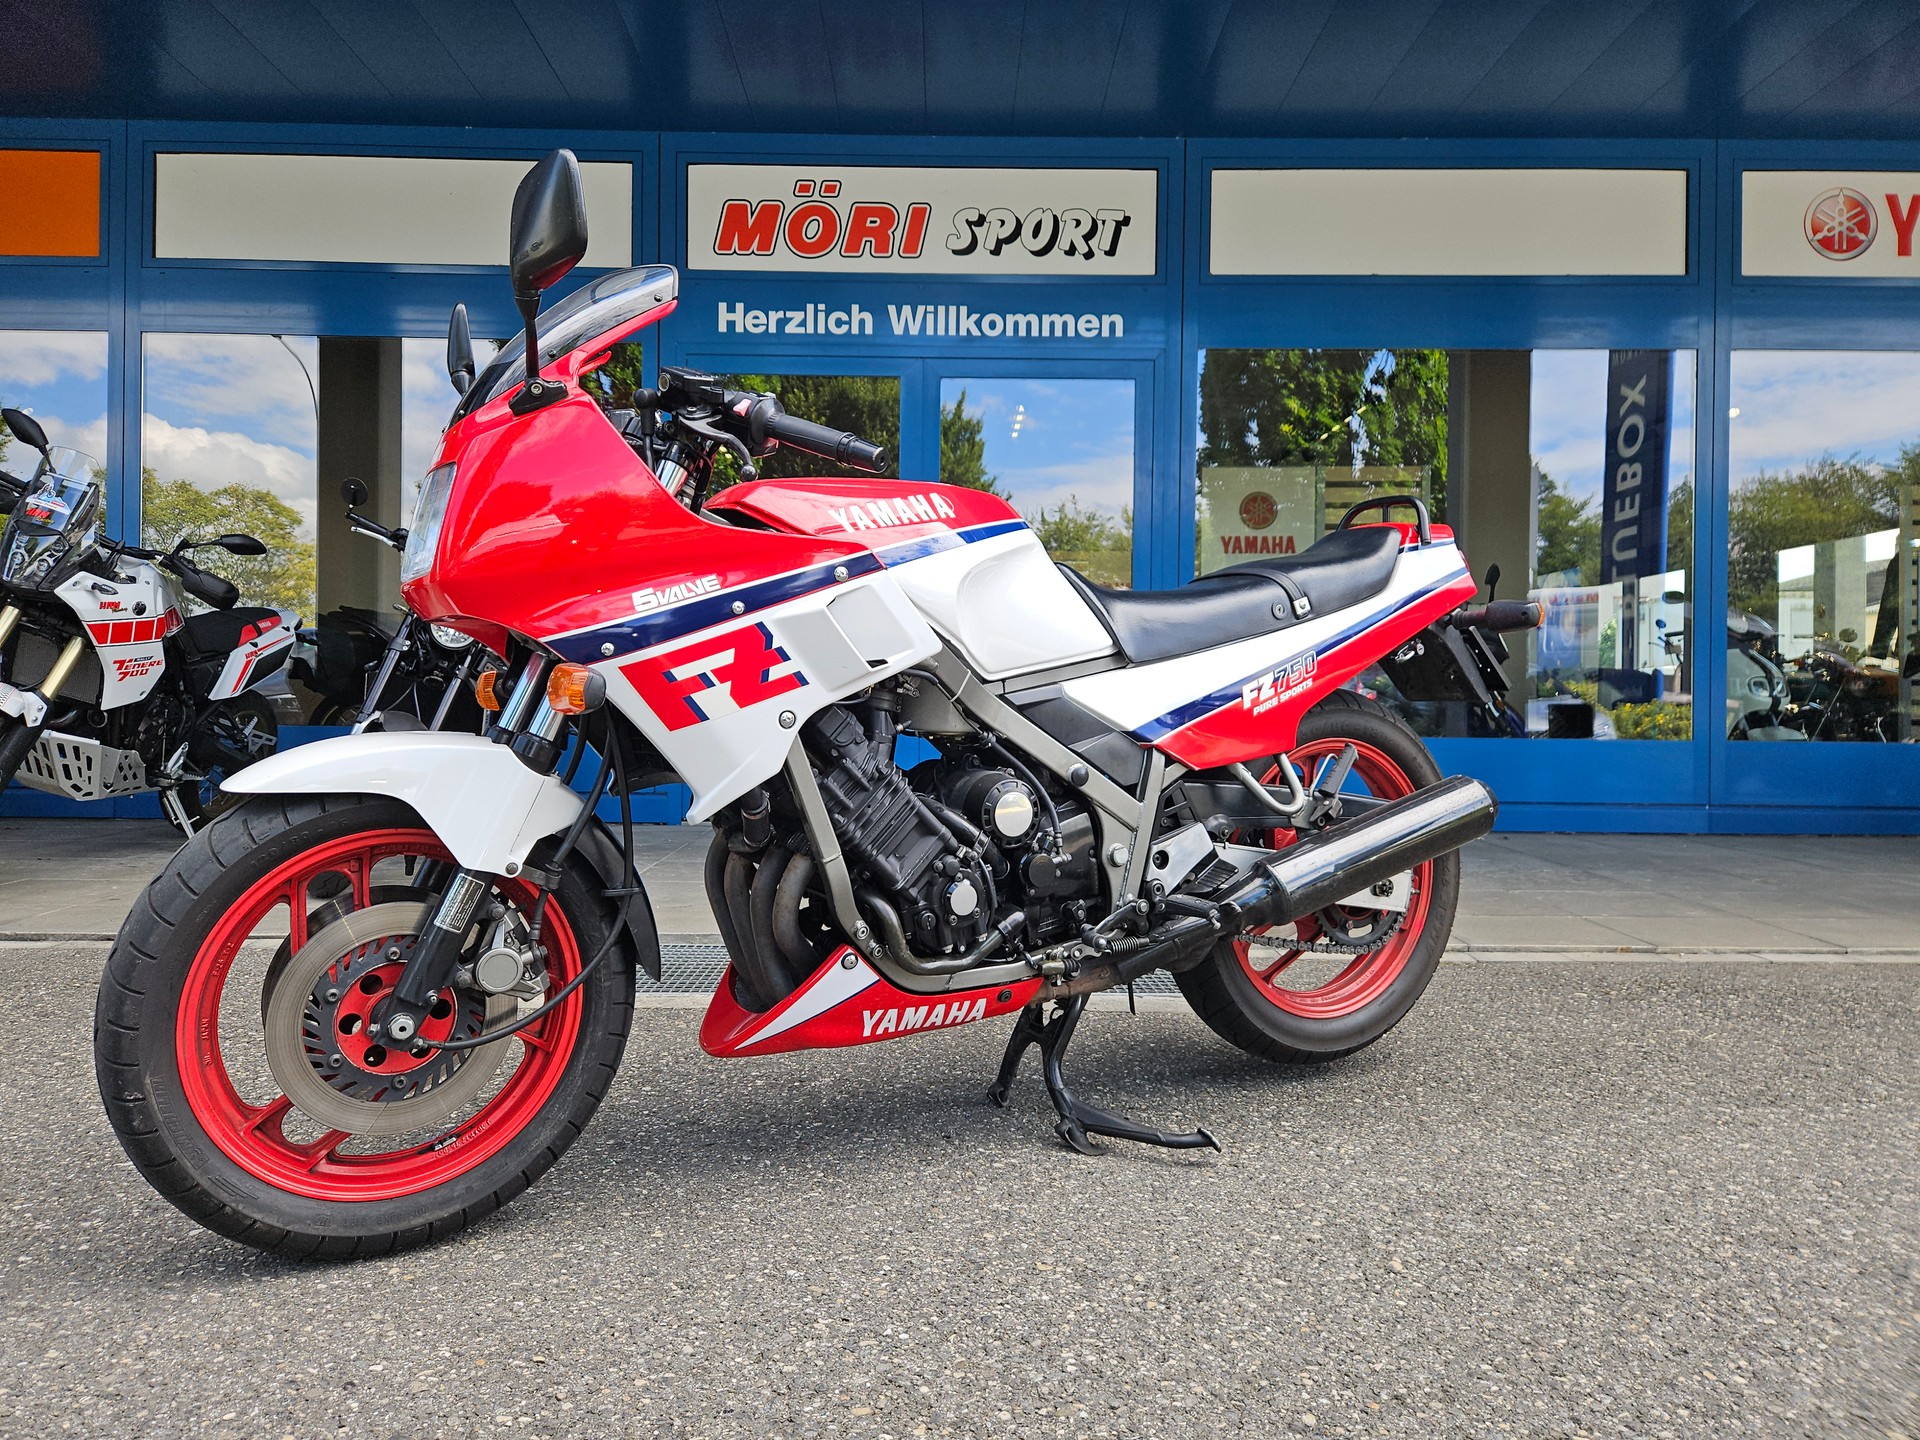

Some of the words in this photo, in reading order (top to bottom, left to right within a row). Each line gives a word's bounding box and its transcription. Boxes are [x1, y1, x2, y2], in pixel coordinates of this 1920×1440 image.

[713, 179, 932, 259] MÖRI
[946, 207, 1132, 261] SPORT
[718, 302, 873, 335] Herzlich
[888, 304, 1124, 338] Willkommen
[828, 492, 956, 533] YAMAHA
[1220, 535, 1296, 554] YAMAHA
[618, 621, 810, 732] FZ
[1253, 696, 1279, 717] PURE
[1279, 677, 1313, 703] SPORTS
[862, 998, 987, 1037] YAMAHA
